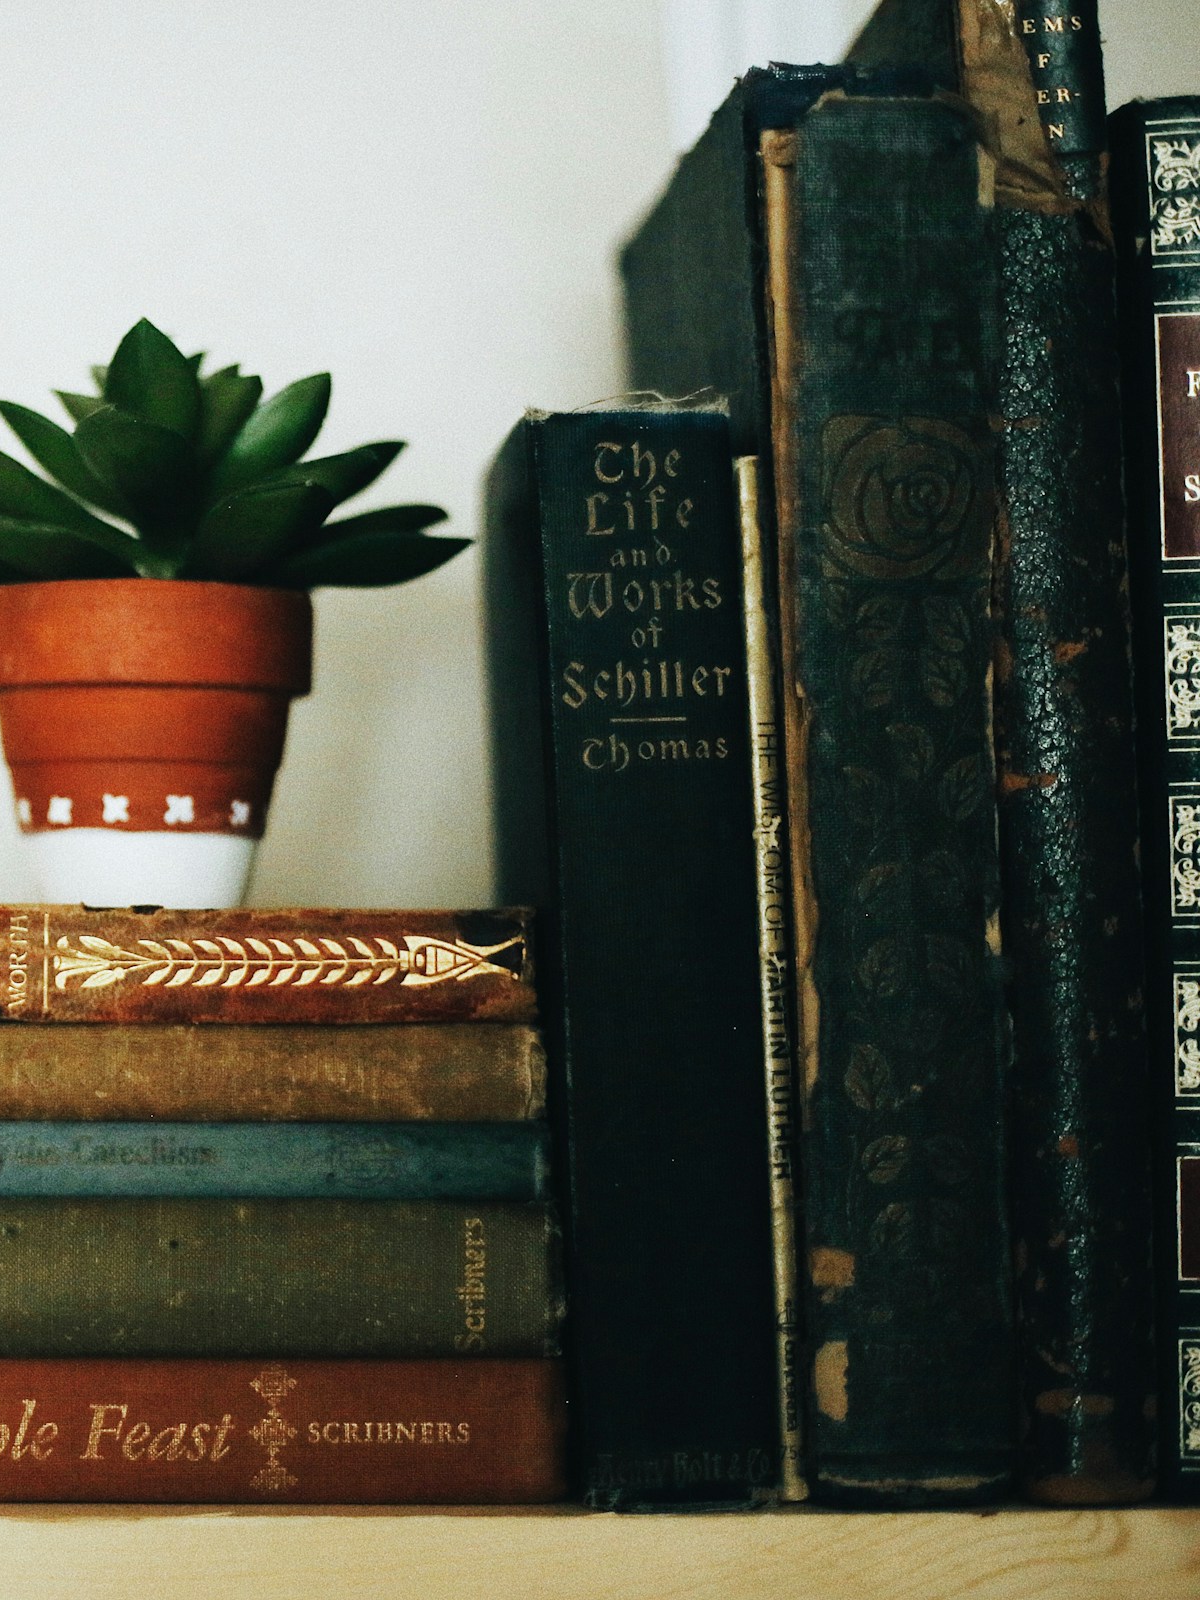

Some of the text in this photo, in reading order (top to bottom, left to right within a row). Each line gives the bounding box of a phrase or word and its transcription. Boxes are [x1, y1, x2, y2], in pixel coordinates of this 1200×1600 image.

[1022, 15, 1082, 34] EMS
[593, 441, 682, 490] The
[585, 484, 694, 536] Life
[609, 535, 672, 567] and
[566, 569, 723, 619] Works
[631, 616, 663, 649] of
[562, 658, 732, 710] Schiller
[582, 732, 729, 773] Thomas
[7, 914, 29, 1008] WORTH
[770, 1069, 794, 1181] LUTHER
[454, 1217, 487, 1349] Scribners
[79, 1403, 237, 1461] Feast
[307, 1421, 471, 1445] SCRIBNERS
